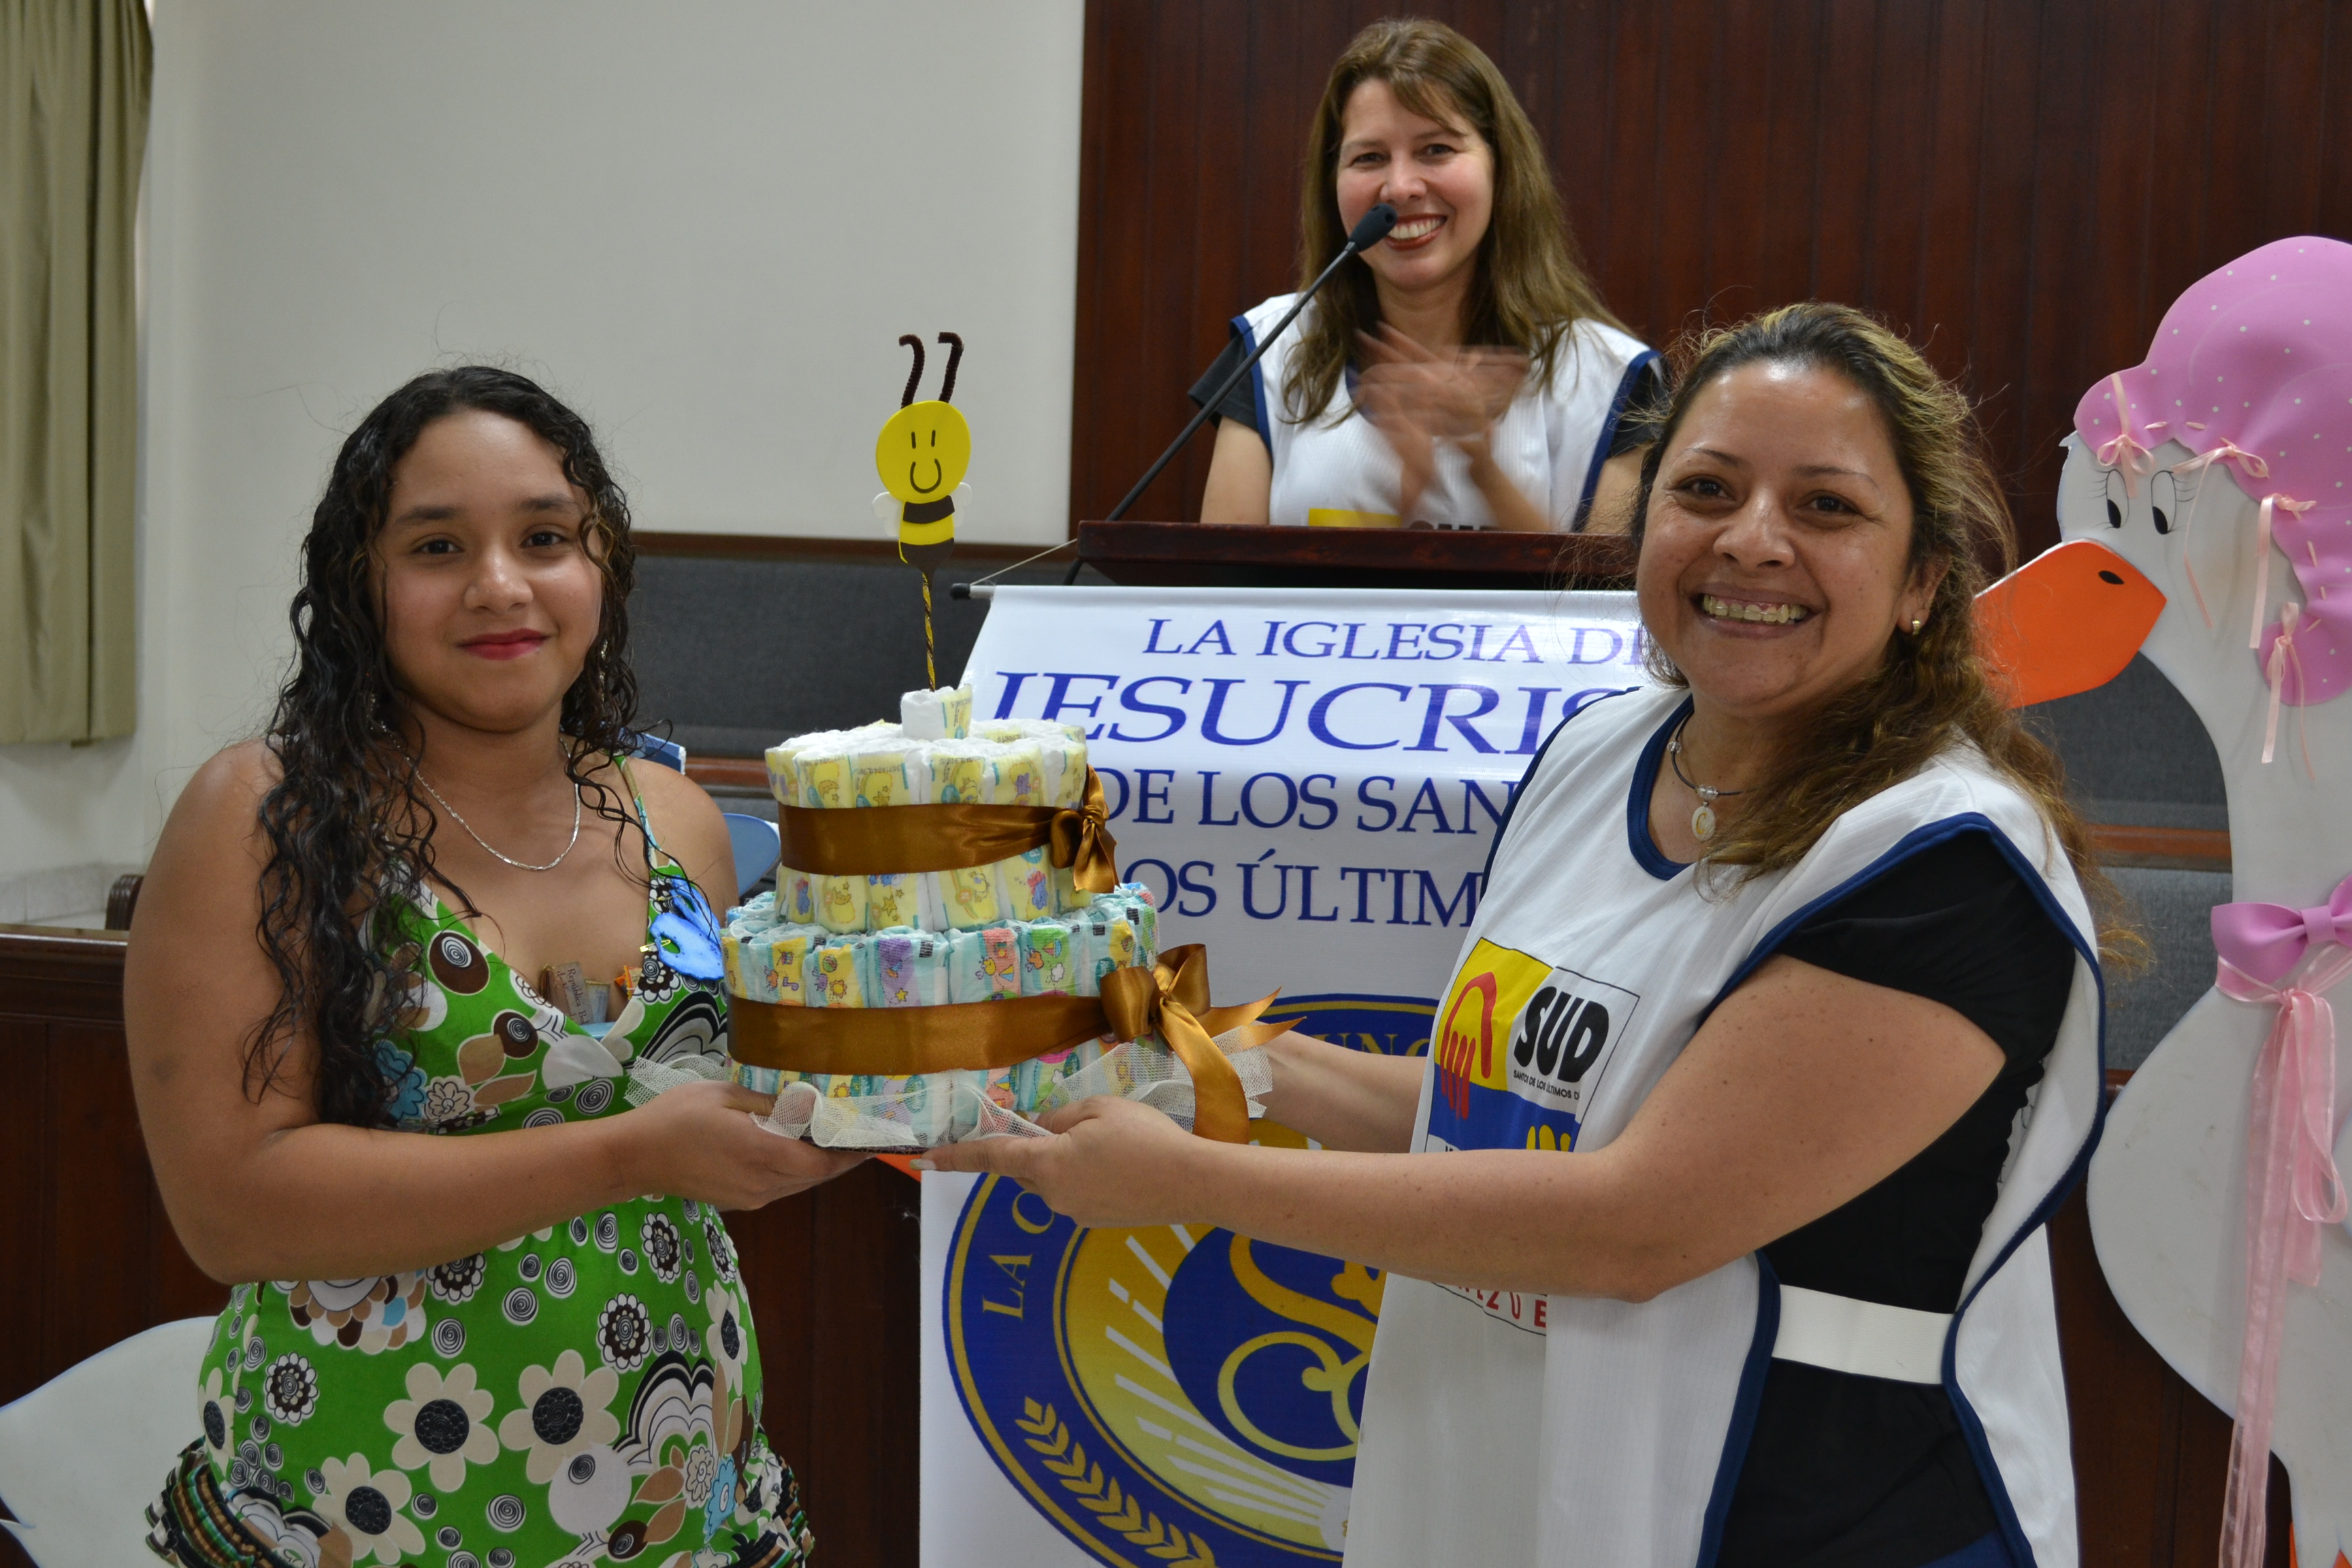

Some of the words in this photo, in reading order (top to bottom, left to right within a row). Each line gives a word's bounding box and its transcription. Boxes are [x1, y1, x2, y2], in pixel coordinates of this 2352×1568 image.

[1144, 618, 1236, 655] LA
[1257, 619, 1548, 664] IGLESIA
[1094, 767, 1175, 824] DE
[1197, 770, 1339, 830] LOS
[1356, 775, 1520, 835] SAN
[1124, 858, 1217, 917] OS
[1239, 849, 1484, 928] ÚLTIM
[1514, 986, 1609, 1083] SUD
[982, 1254, 1033, 1321] LA
